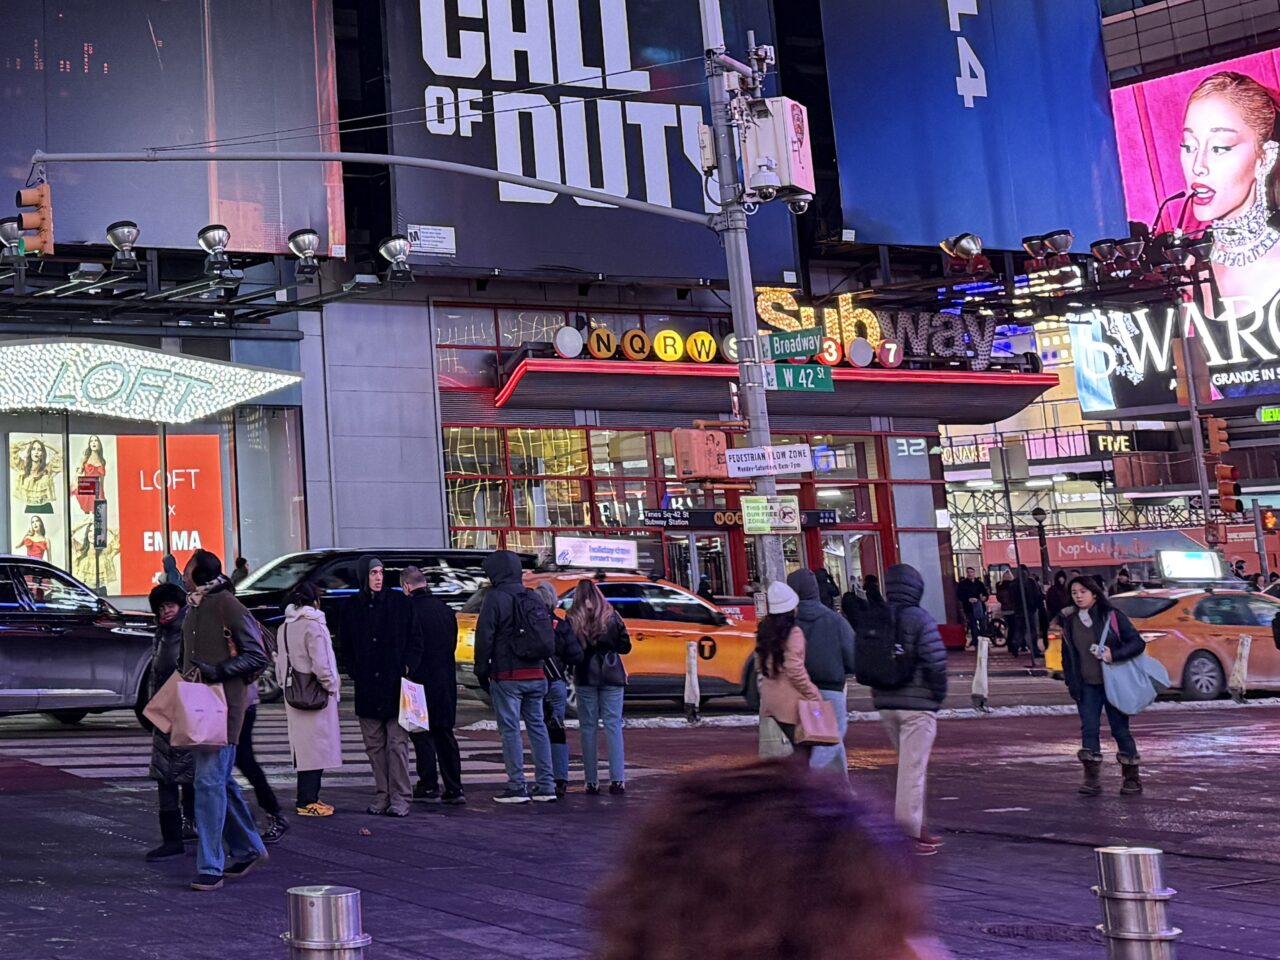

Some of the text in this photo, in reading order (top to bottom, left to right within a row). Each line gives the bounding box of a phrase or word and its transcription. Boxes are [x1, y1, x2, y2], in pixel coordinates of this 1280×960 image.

[424, 85, 483, 138] OF
[1072, 289, 1280, 379] SWAR
[596, 333, 612, 353] N
[629, 333, 646, 355] Q
[663, 336, 678, 355] R
[693, 338, 713, 359] W
[822, 340, 838, 362] 3
[884, 343, 897, 363] 7
[773, 334, 821, 355] Broadway
[783, 368, 793, 388] W
[798, 368, 815, 388] 42
[1212, 369, 1275, 386] GRANDE IN
[46, 360, 214, 416] LOFT
[1098, 435, 1131, 452] FIVE
[728, 451, 766, 463] PEDESTRIAN
[788, 448, 808, 459] ZONE
[140, 468, 200, 490] LOFT
[644, 519, 667, 527] Subway
[663, 511, 682, 519] Sq-42
[700, 640, 714, 658] T
